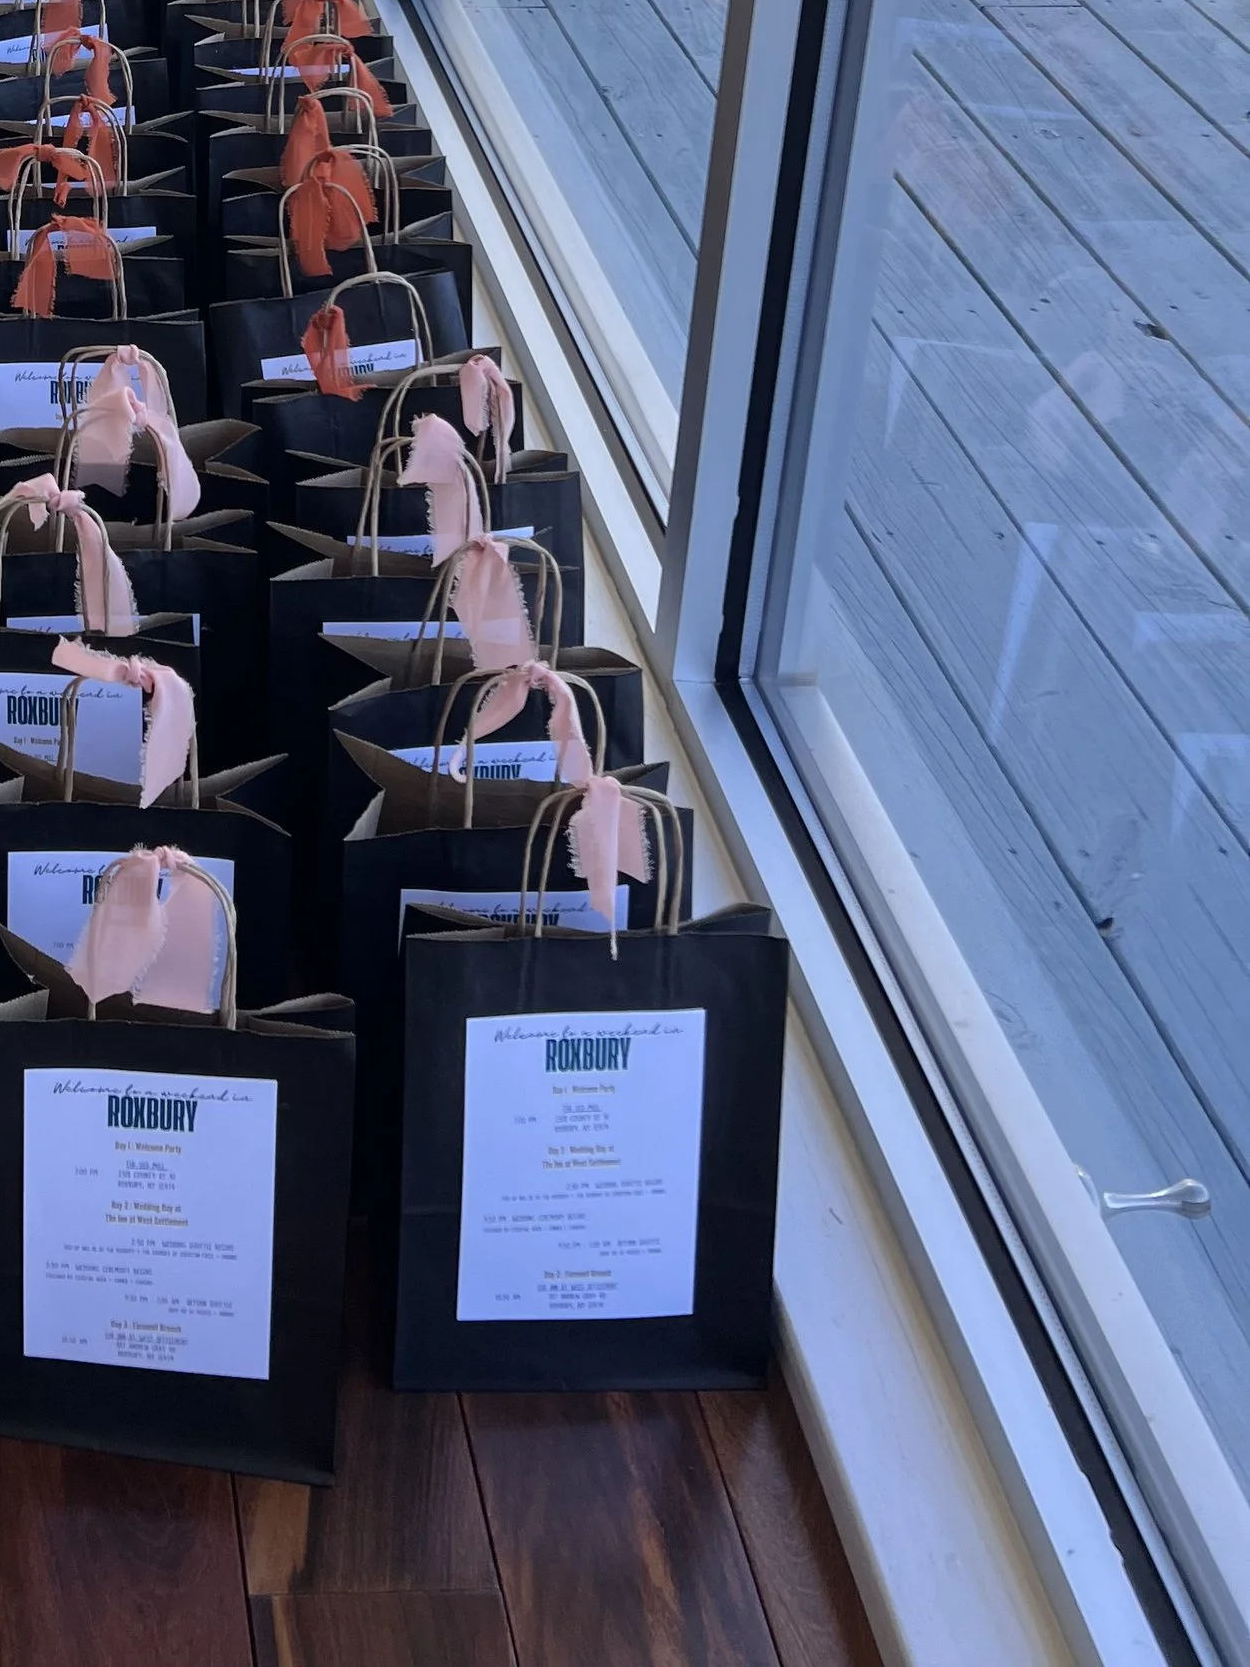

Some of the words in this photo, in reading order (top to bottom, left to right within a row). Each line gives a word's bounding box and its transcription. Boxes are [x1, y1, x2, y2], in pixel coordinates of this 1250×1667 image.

[20, 685, 35, 696] to
[34, 862, 96, 876] Welcome
[494, 1026, 560, 1042] Welcome
[596, 1022, 660, 1037] weekend
[545, 1037, 631, 1073] ROXBURY
[53, 1080, 122, 1095] Welcome
[125, 1084, 143, 1096] to
[161, 1086, 229, 1103] weekend
[107, 1095, 197, 1133] ROXBURY
[115, 1141, 127, 1152] Day
[165, 1144, 182, 1155] Party
[111, 1201, 124, 1212] Day
[111, 1320, 122, 1330] Day
